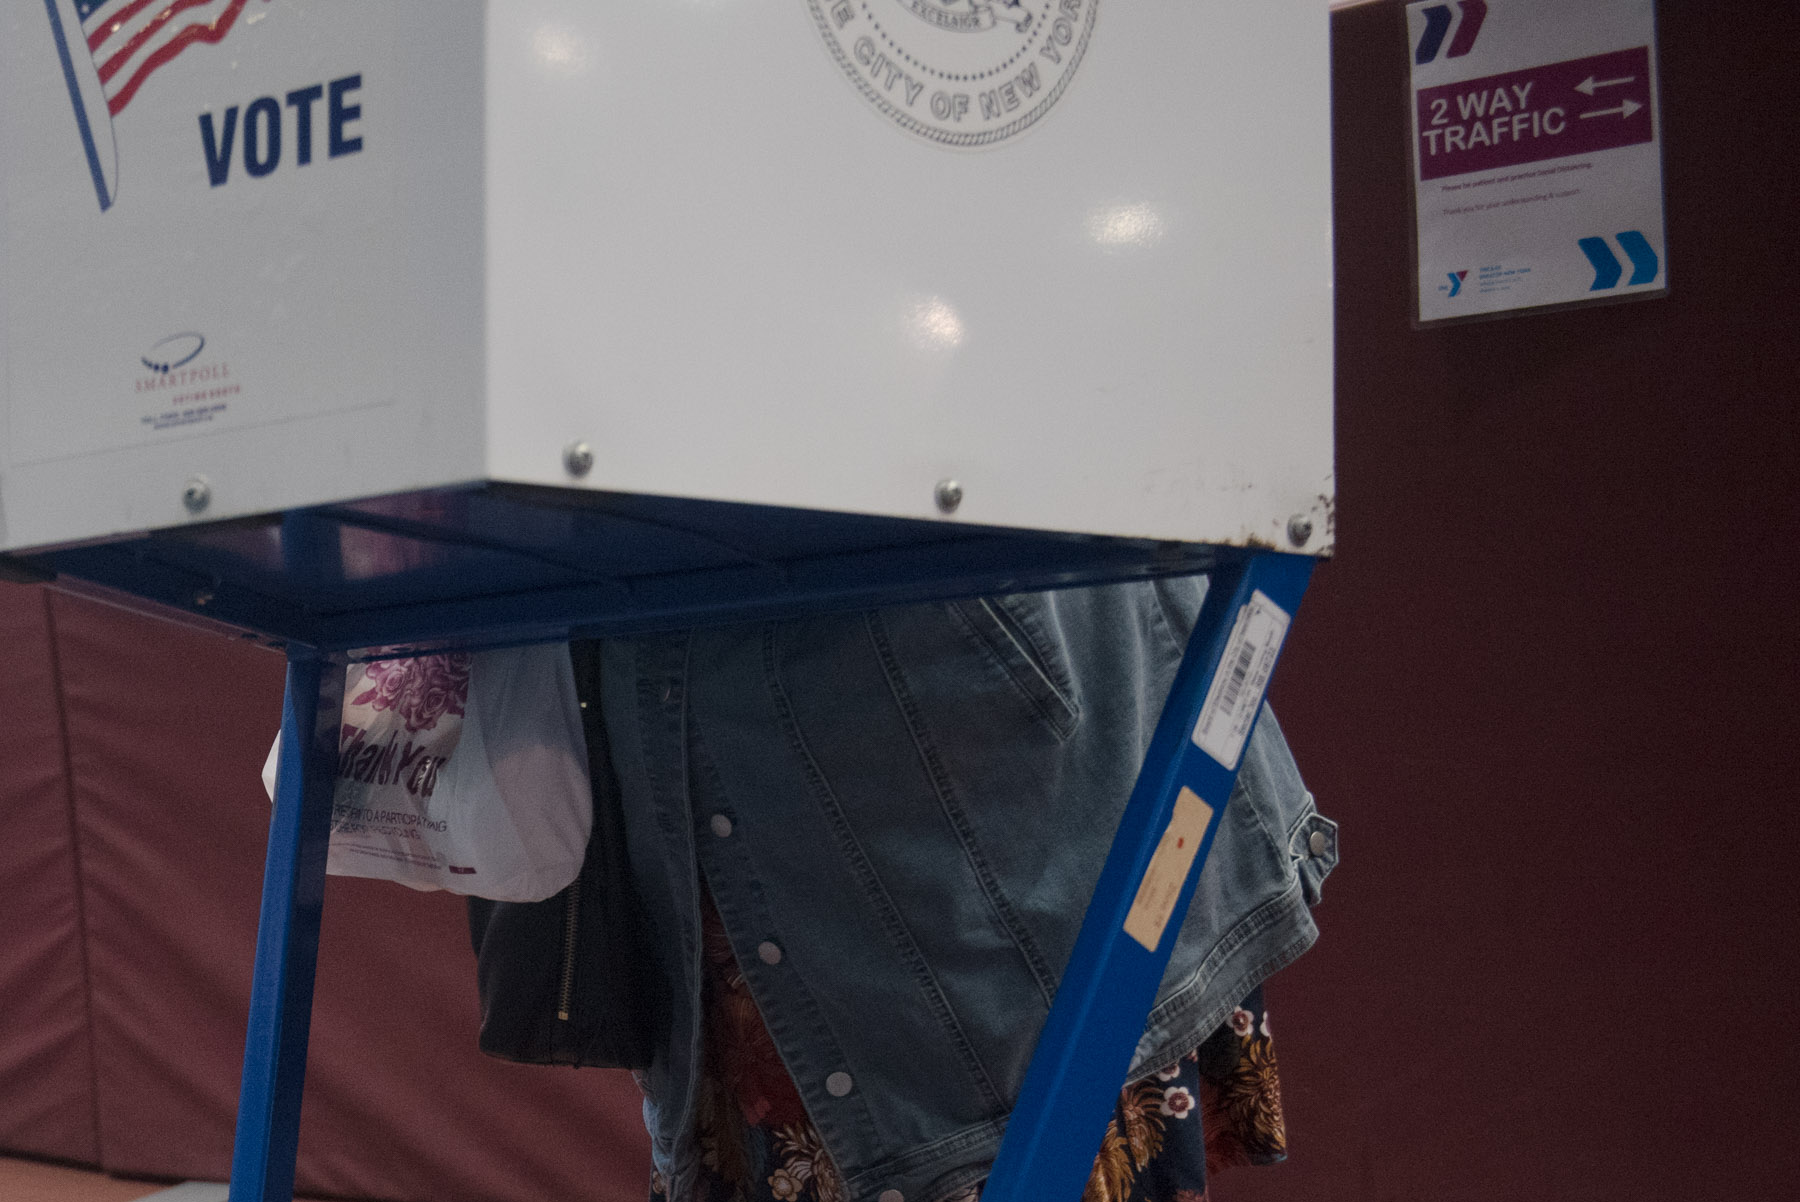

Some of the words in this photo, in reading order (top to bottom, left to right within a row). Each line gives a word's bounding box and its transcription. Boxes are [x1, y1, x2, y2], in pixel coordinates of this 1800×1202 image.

[853, 35, 924, 107] CITY
[930, 90, 969, 122] OF
[978, 62, 1041, 121] NEW
[1039, 0, 1081, 66] YOR
[1431, 98, 1450, 126] 2
[1456, 83, 1534, 121] WAY
[199, 73, 363, 188] VOTE
[1422, 107, 1566, 156] TRAFFIC
[380, 810, 447, 833] PARTICIPATING
